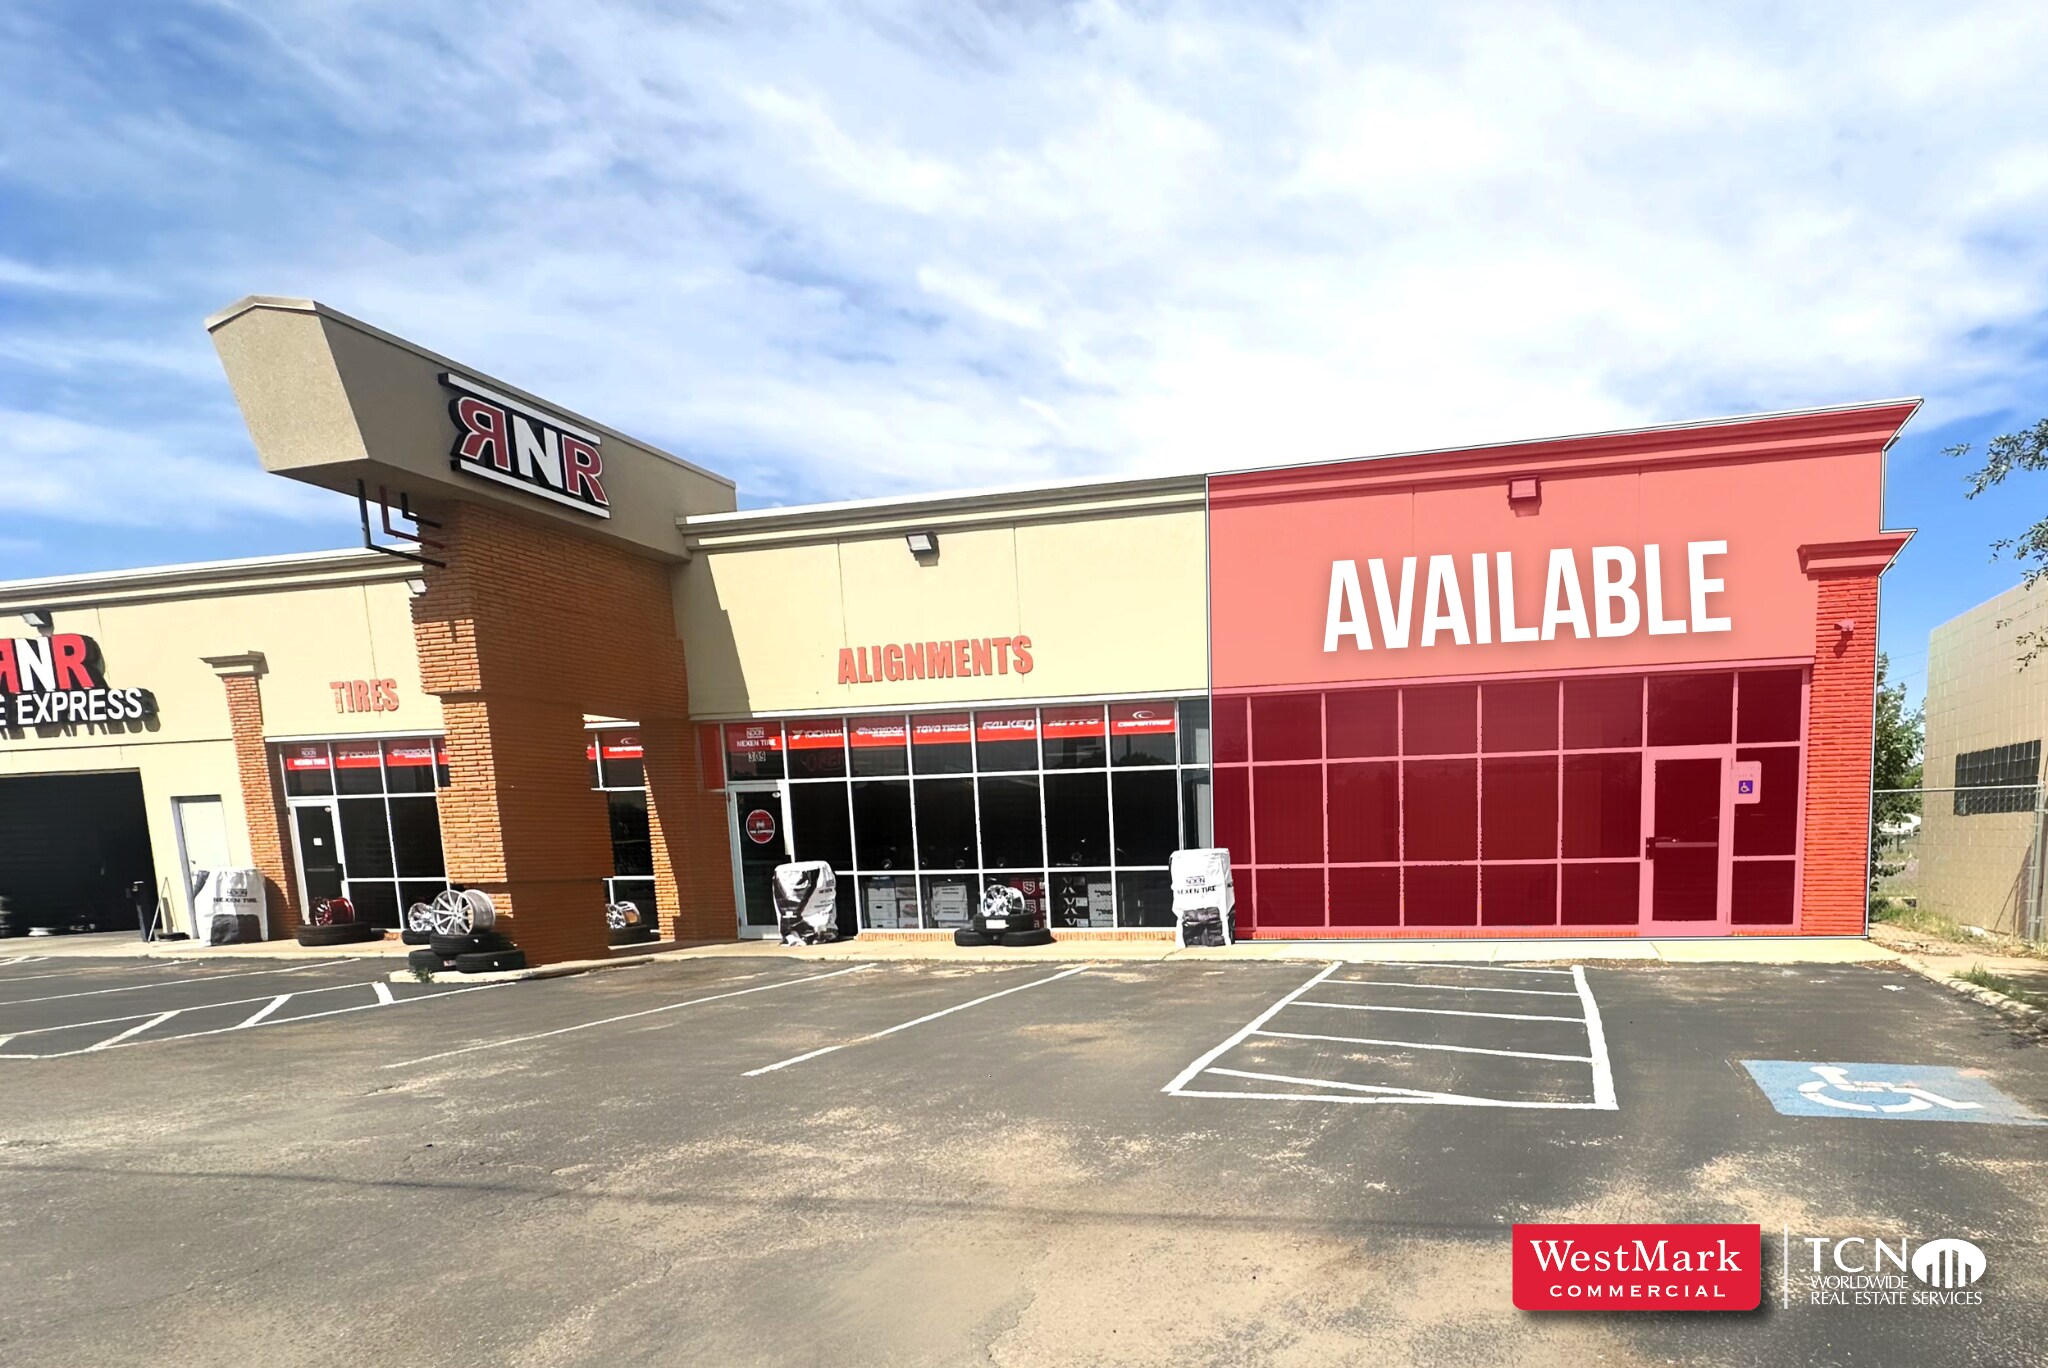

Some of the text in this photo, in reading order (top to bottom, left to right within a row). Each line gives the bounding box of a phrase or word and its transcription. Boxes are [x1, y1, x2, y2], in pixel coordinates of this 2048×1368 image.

[458, 396, 610, 506] RNR
[838, 635, 1034, 684] ALIGNMENTS
[17, 687, 143, 725] EXPRESS
[330, 678, 399, 714] TIRES
[916, 725, 941, 734] TOYO
